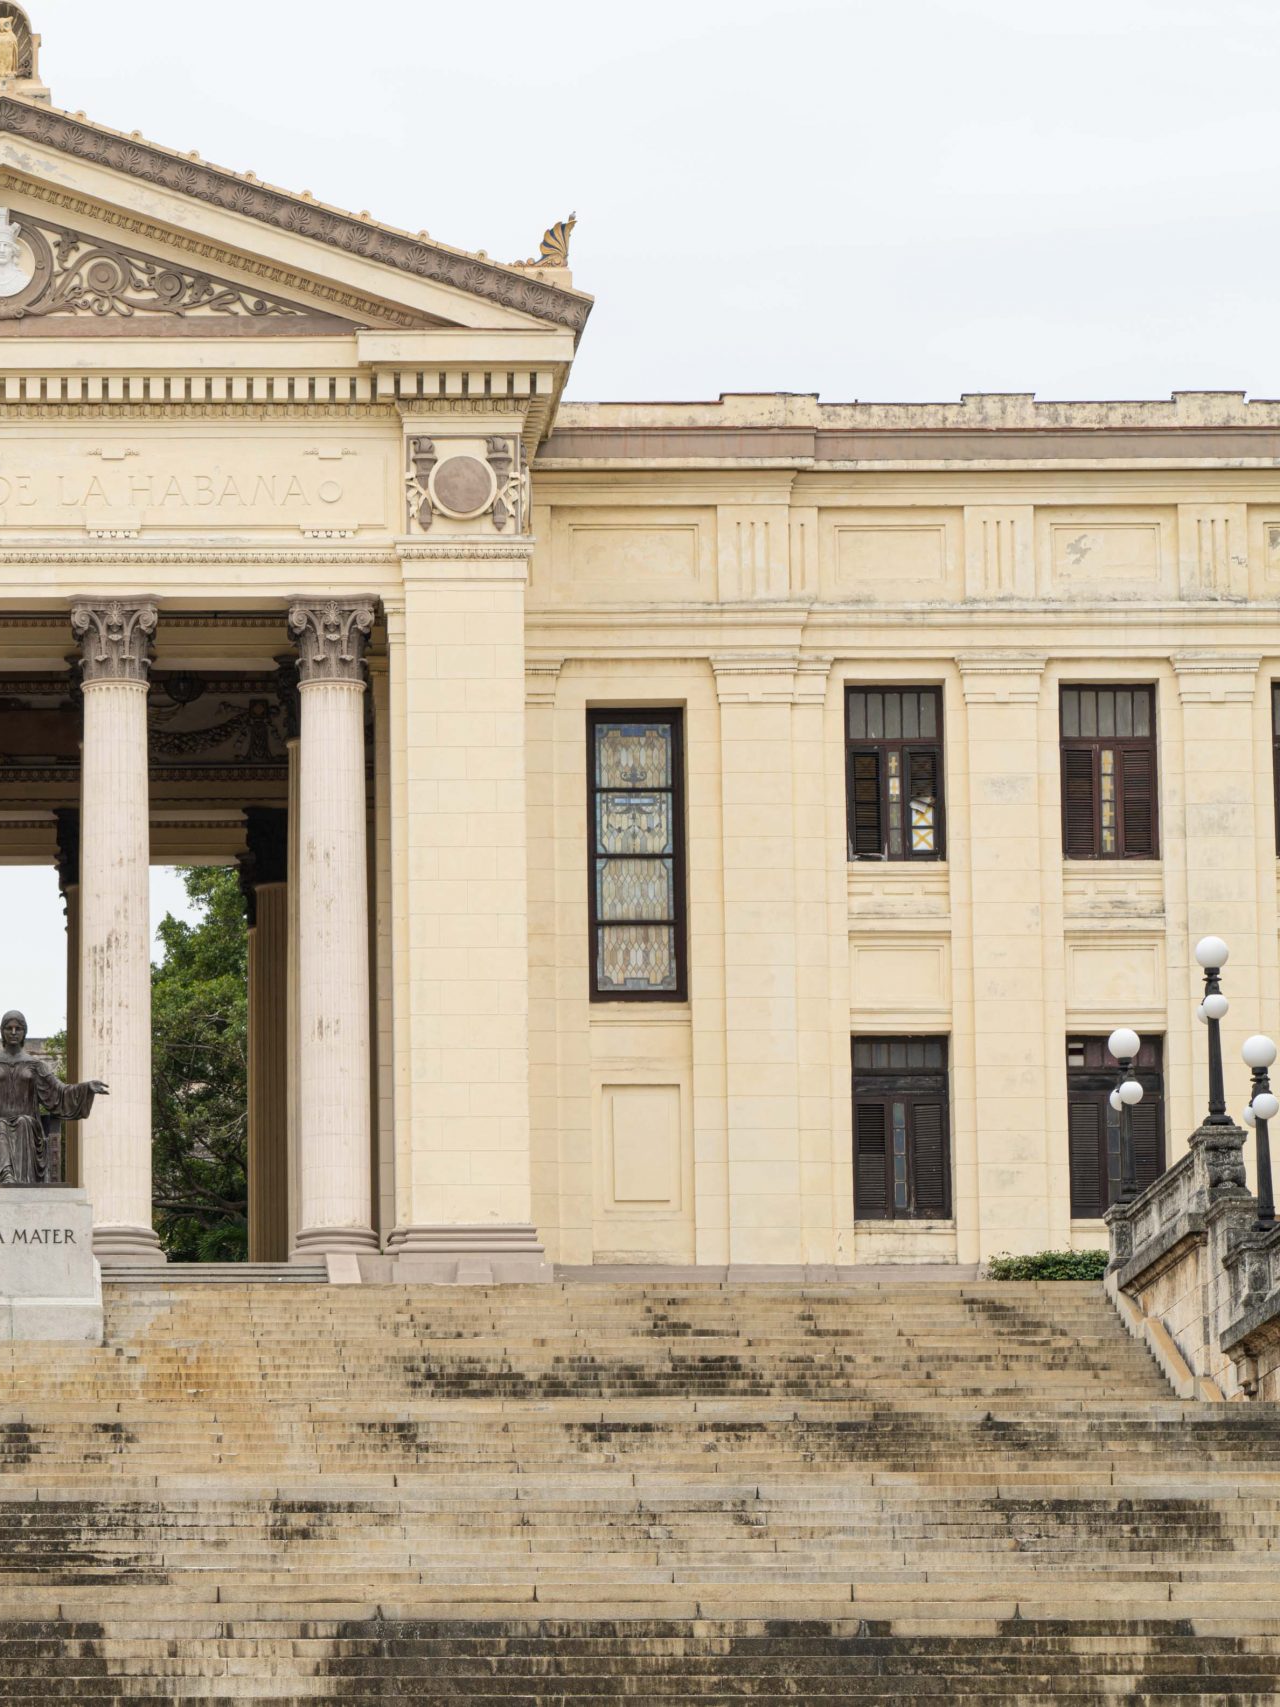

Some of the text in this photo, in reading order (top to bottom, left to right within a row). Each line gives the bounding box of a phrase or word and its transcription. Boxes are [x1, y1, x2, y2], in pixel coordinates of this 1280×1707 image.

[57, 475, 112, 507] LA
[127, 475, 312, 507] HABANA
[11, 1228, 78, 1245] MATER
